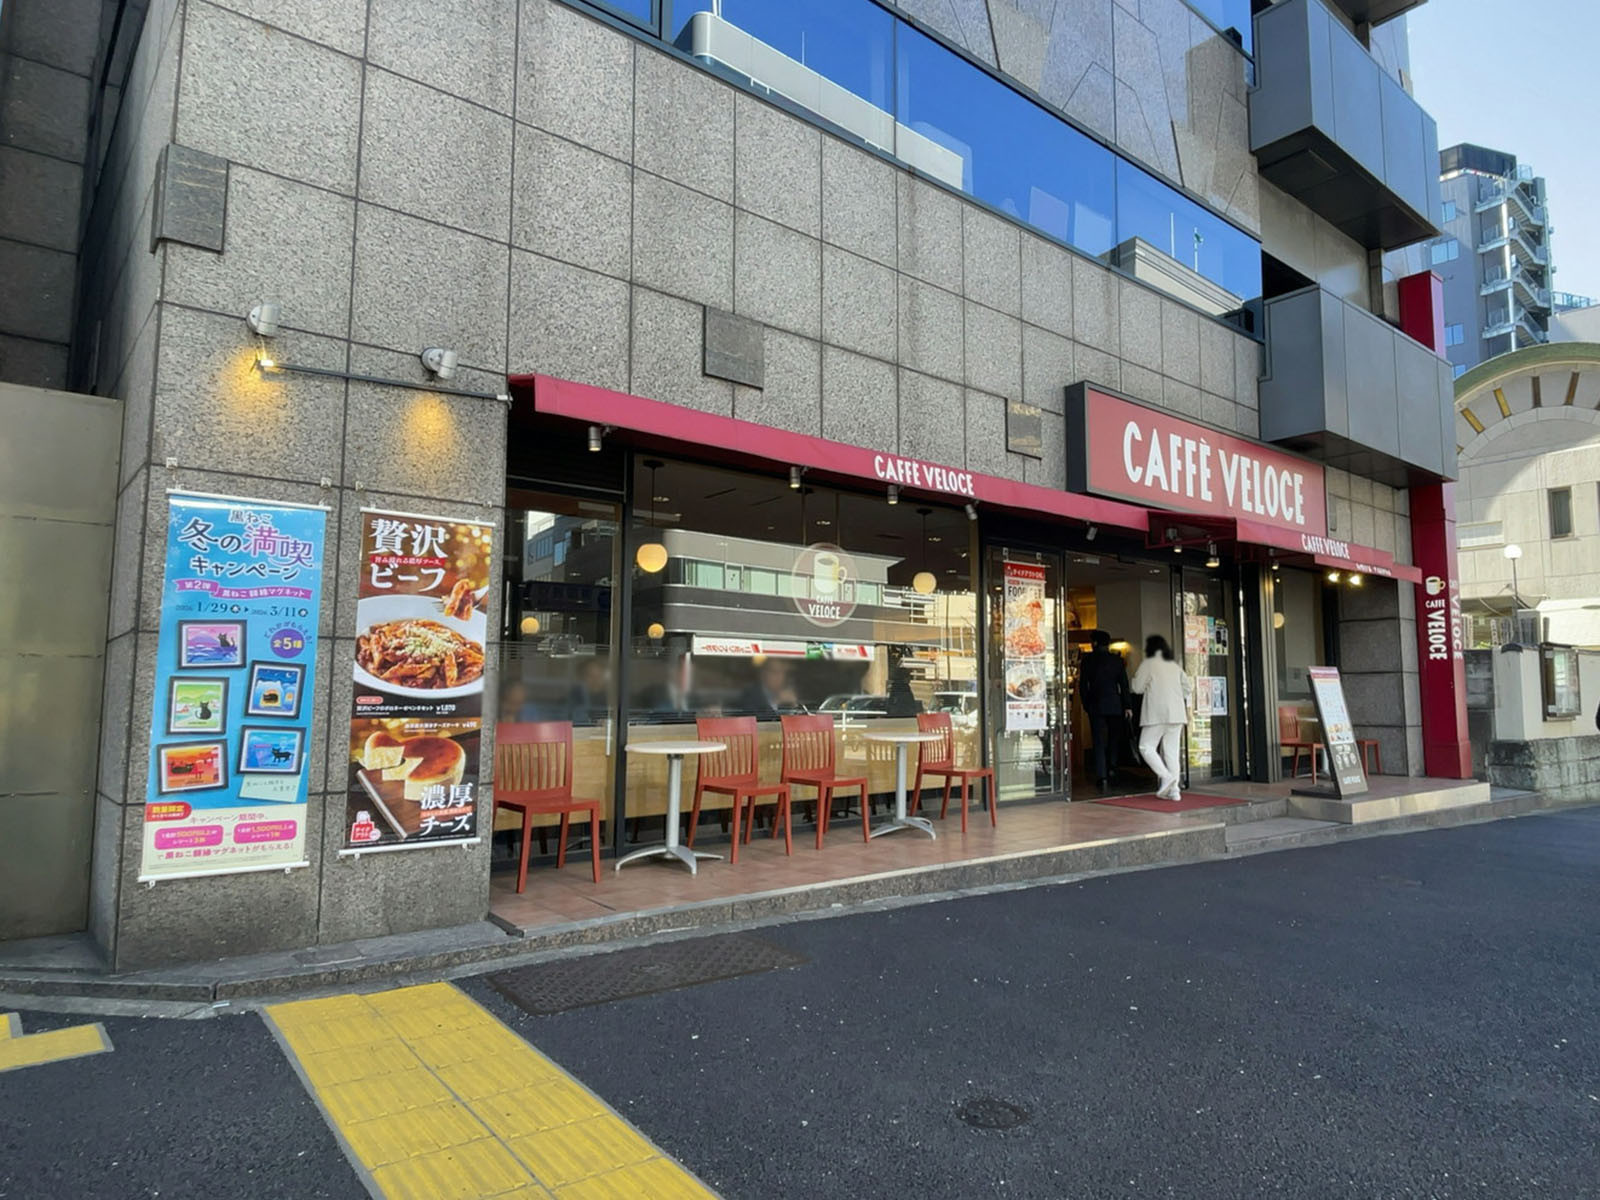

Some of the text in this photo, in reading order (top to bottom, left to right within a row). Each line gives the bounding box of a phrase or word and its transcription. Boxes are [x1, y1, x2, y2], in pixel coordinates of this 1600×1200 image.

[922, 465, 974, 495] VELOCE
[1123, 421, 1305, 525] CAFFÈ VELOCE
[230, 510, 273, 525] 黒ねこ
[179, 518, 313, 568] 冬の満喫
[368, 518, 448, 558] 贅沢
[1323, 538, 1350, 559] VELOCE
[192, 556, 299, 580] キャンペーン
[370, 562, 446, 592] ビーフ
[197, 602, 228, 613] 1/29
[270, 606, 296, 617] 3/11
[808, 604, 841, 619] VELOCE
[1427, 609, 1448, 660] VELOCE
[1451, 595, 1463, 660] VELOCE
[420, 782, 473, 810] 濃厚
[420, 812, 473, 836] チーズ
